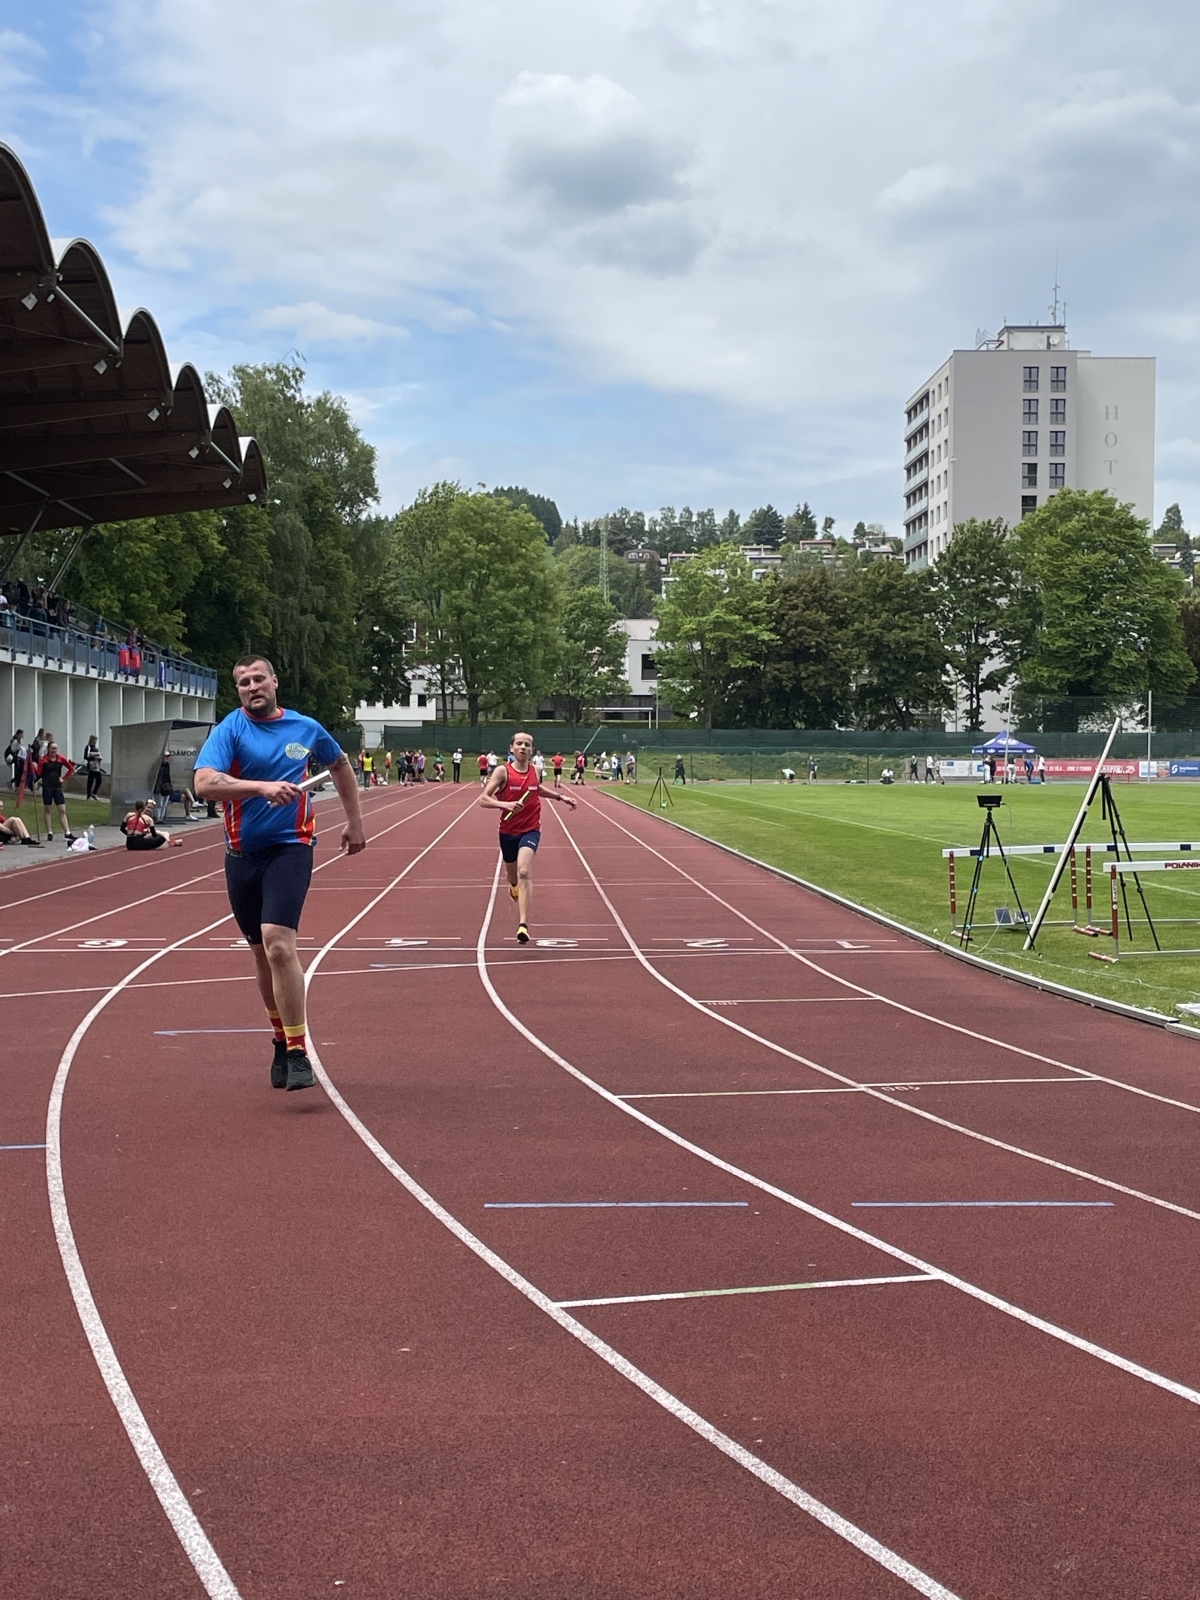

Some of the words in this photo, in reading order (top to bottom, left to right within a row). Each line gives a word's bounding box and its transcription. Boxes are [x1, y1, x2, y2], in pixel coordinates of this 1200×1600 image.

[385, 938, 429, 948] 4
[535, 938, 579, 948] 3
[683, 938, 729, 948] 2
[836, 939, 871, 949] 1
